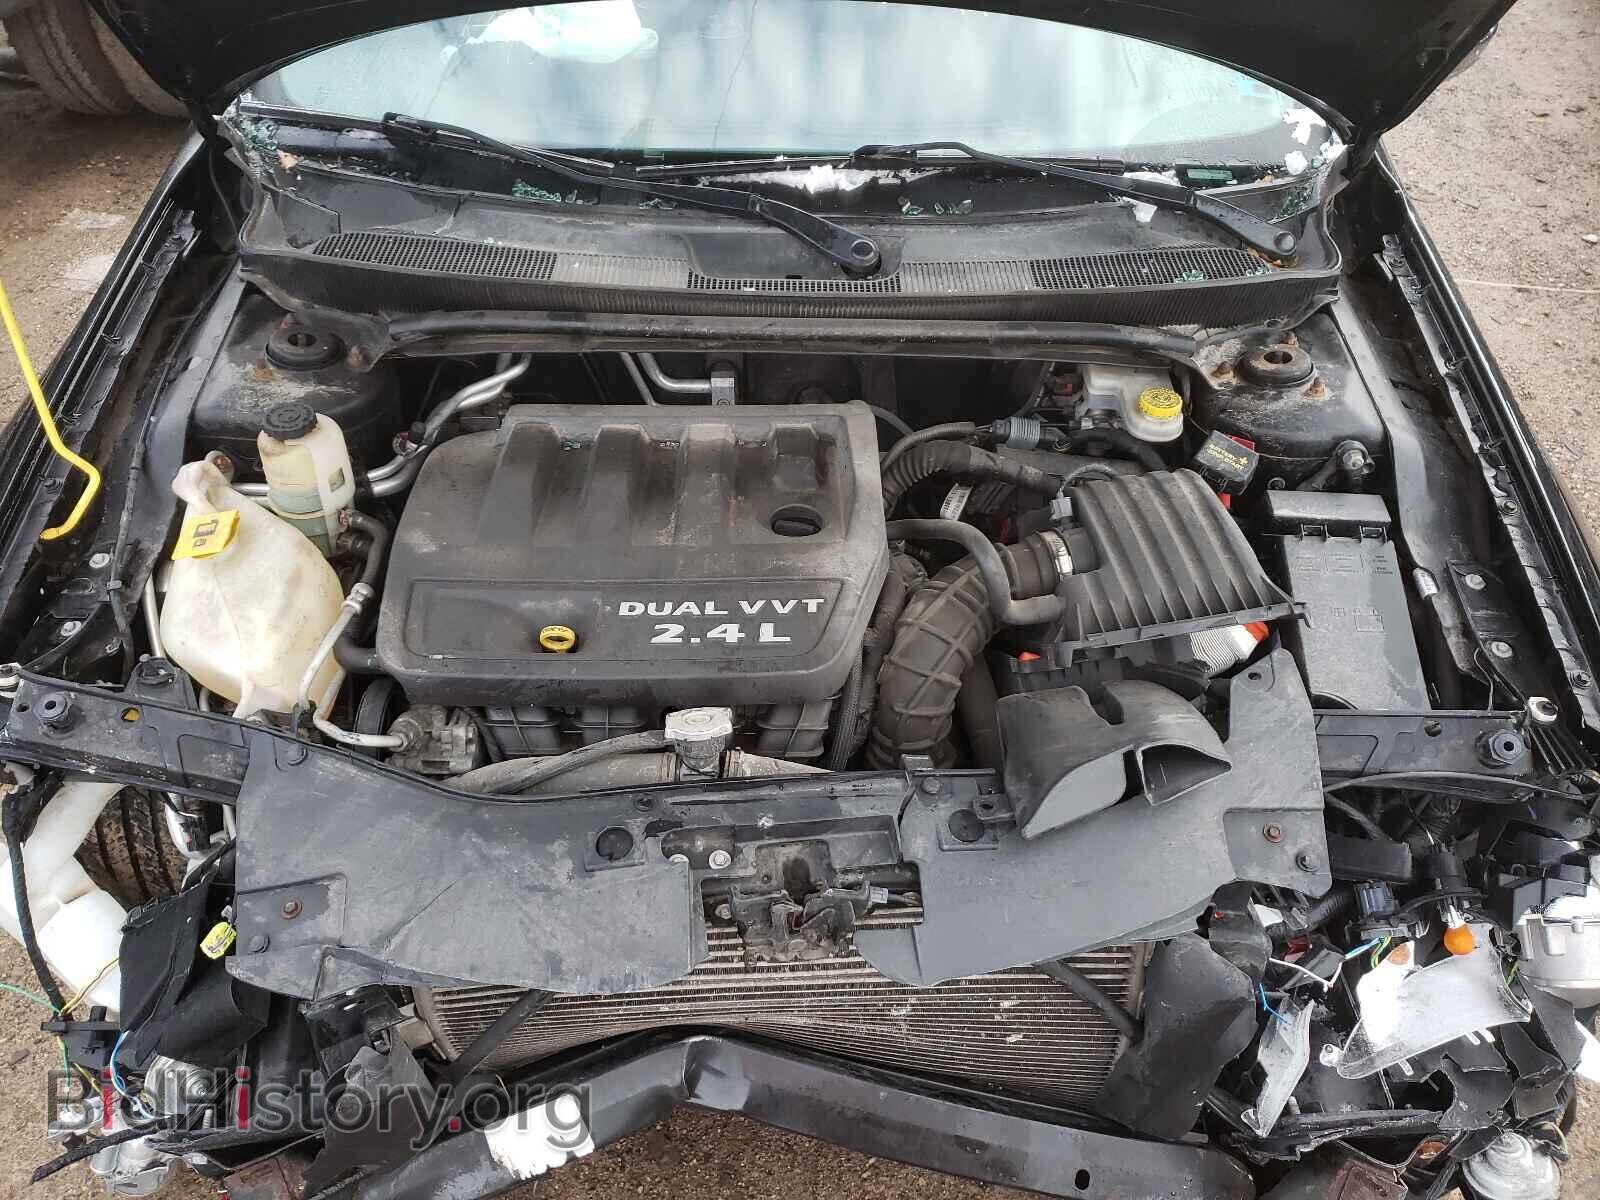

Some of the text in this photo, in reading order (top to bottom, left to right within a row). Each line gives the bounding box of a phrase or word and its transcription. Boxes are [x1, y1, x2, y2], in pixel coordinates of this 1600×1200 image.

[618, 598, 825, 616] DUAL VVT
[650, 623, 746, 644] 2.4
